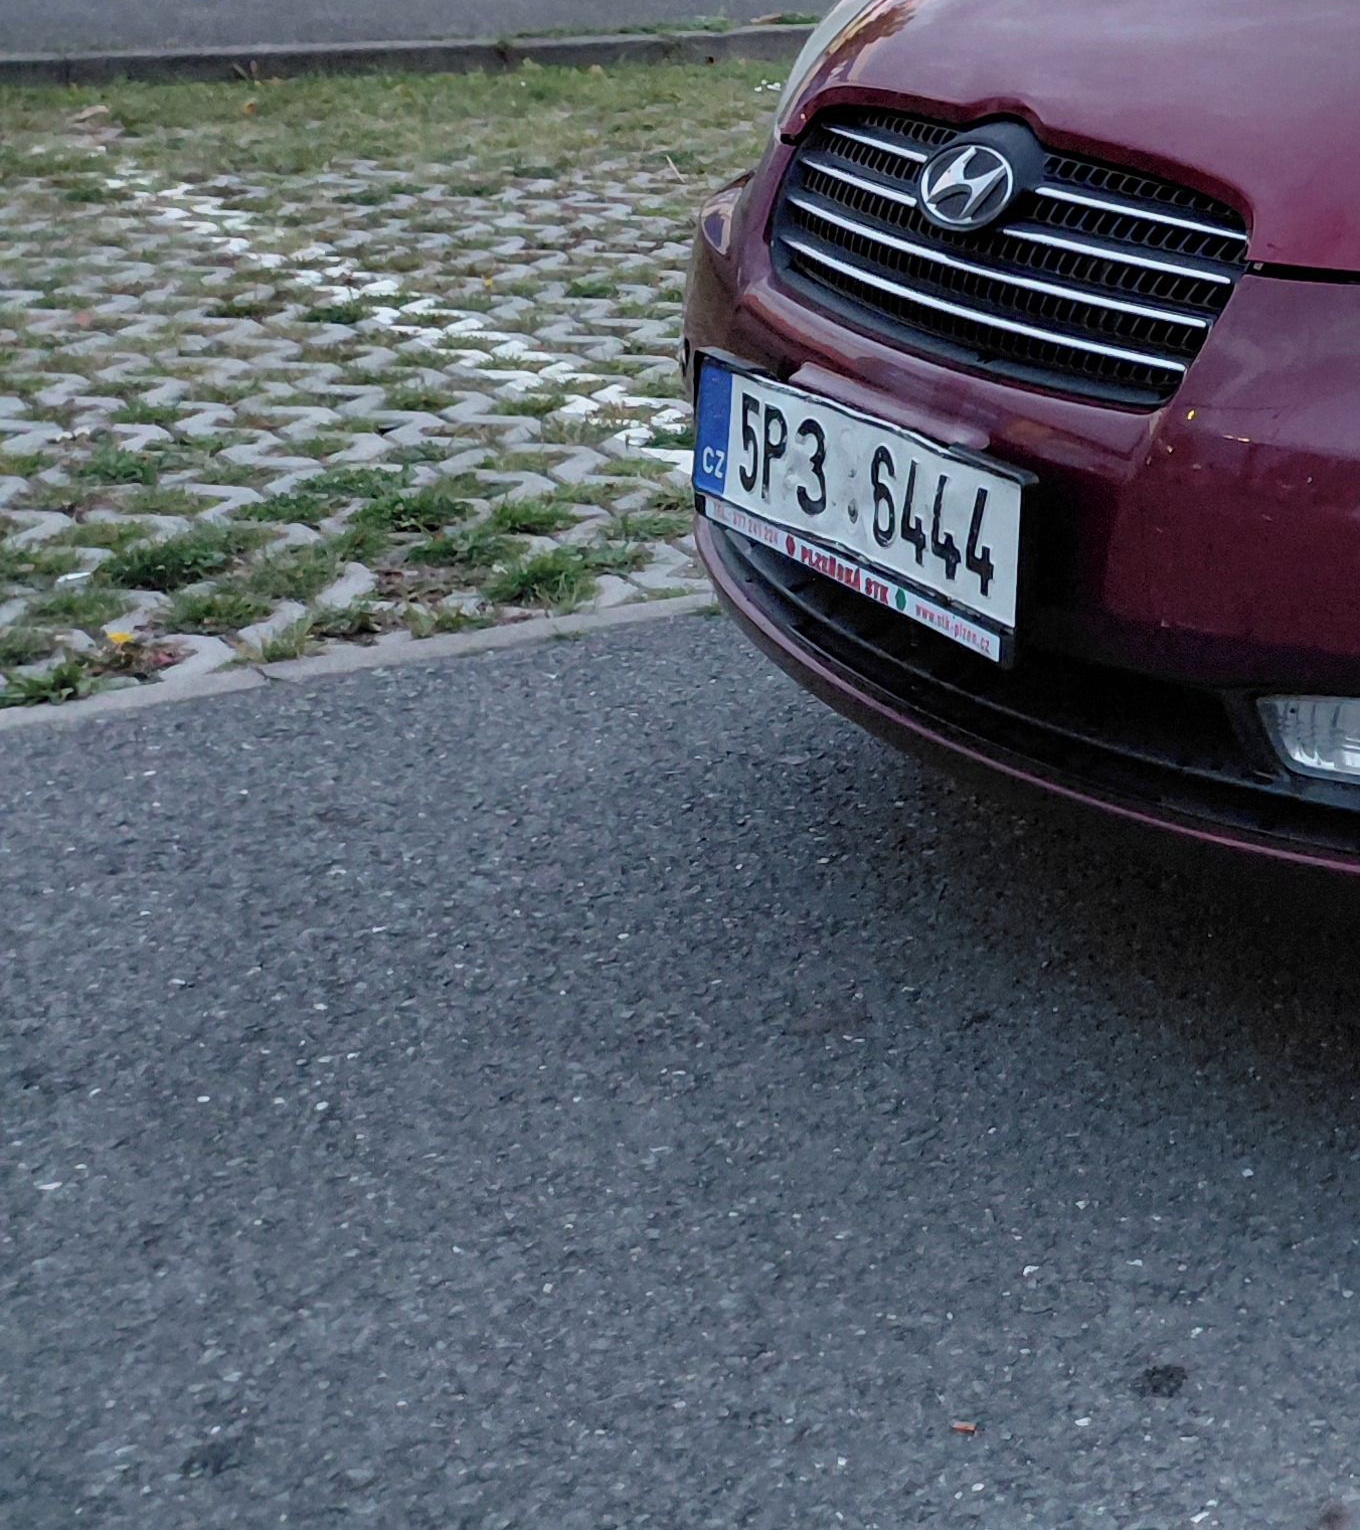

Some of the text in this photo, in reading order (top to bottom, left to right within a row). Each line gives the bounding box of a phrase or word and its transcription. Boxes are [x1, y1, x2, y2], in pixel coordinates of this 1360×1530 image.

[702, 445, 726, 479] CZ
[739, 391, 995, 598] 5P3 6444
[865, 577, 889, 606] STK
